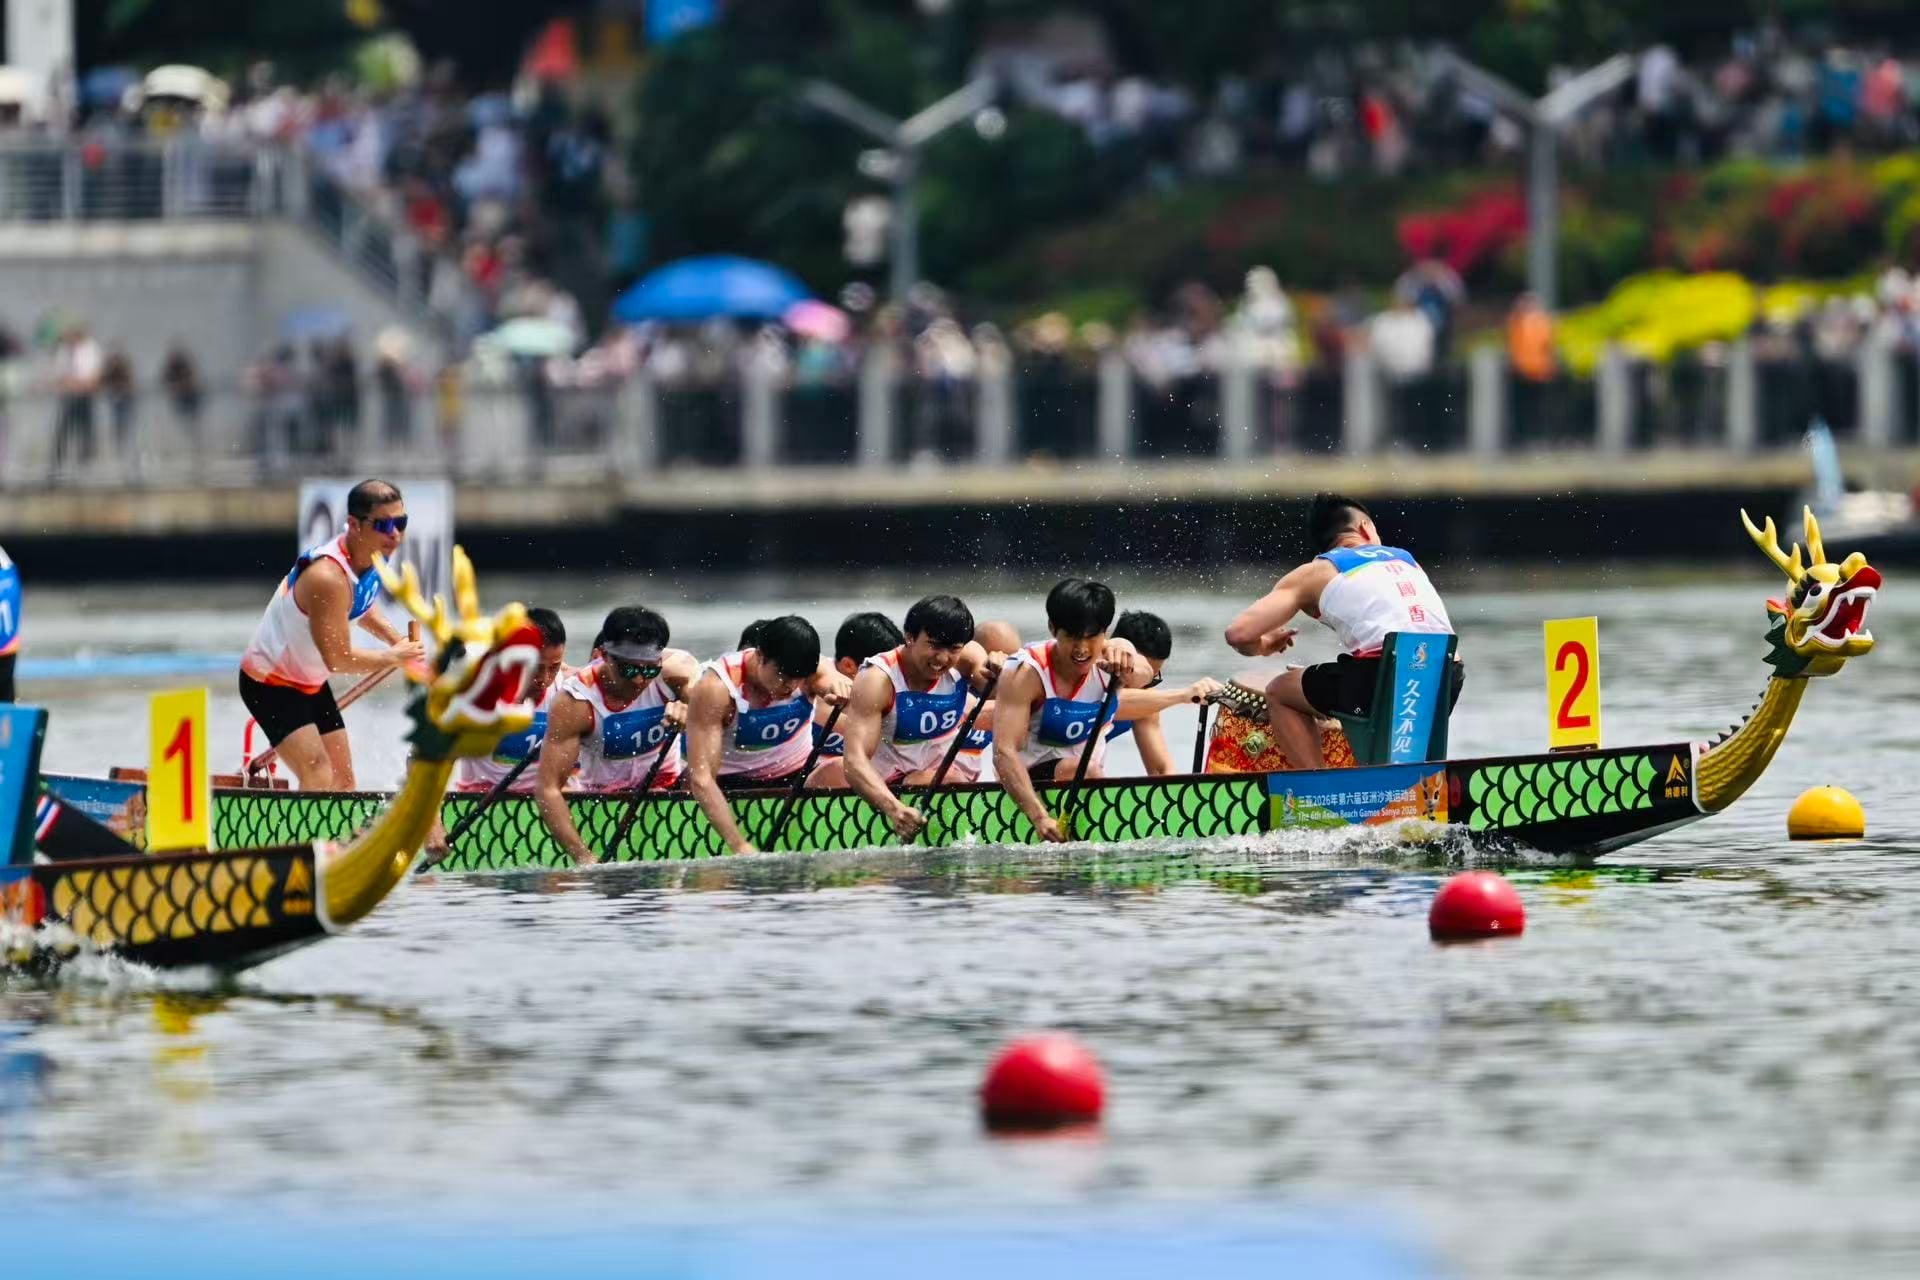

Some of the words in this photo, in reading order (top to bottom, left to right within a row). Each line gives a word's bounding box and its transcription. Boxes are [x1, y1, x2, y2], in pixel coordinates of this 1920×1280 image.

[1555, 641, 1590, 729] 2
[762, 718, 800, 740] 09
[920, 710, 957, 734] 08
[1392, 679, 1421, 763] 久久不见
[631, 724, 665, 748] 10
[165, 717, 193, 822] 1
[1298, 811, 1310, 821] The
[1311, 810, 1322, 820] 6th
[1322, 809, 1340, 819] Asian
[1340, 808, 1359, 819] Beach
[1359, 808, 1380, 818] Games
[1381, 807, 1401, 818] Sanya
[1402, 805, 1417, 817] 2026
